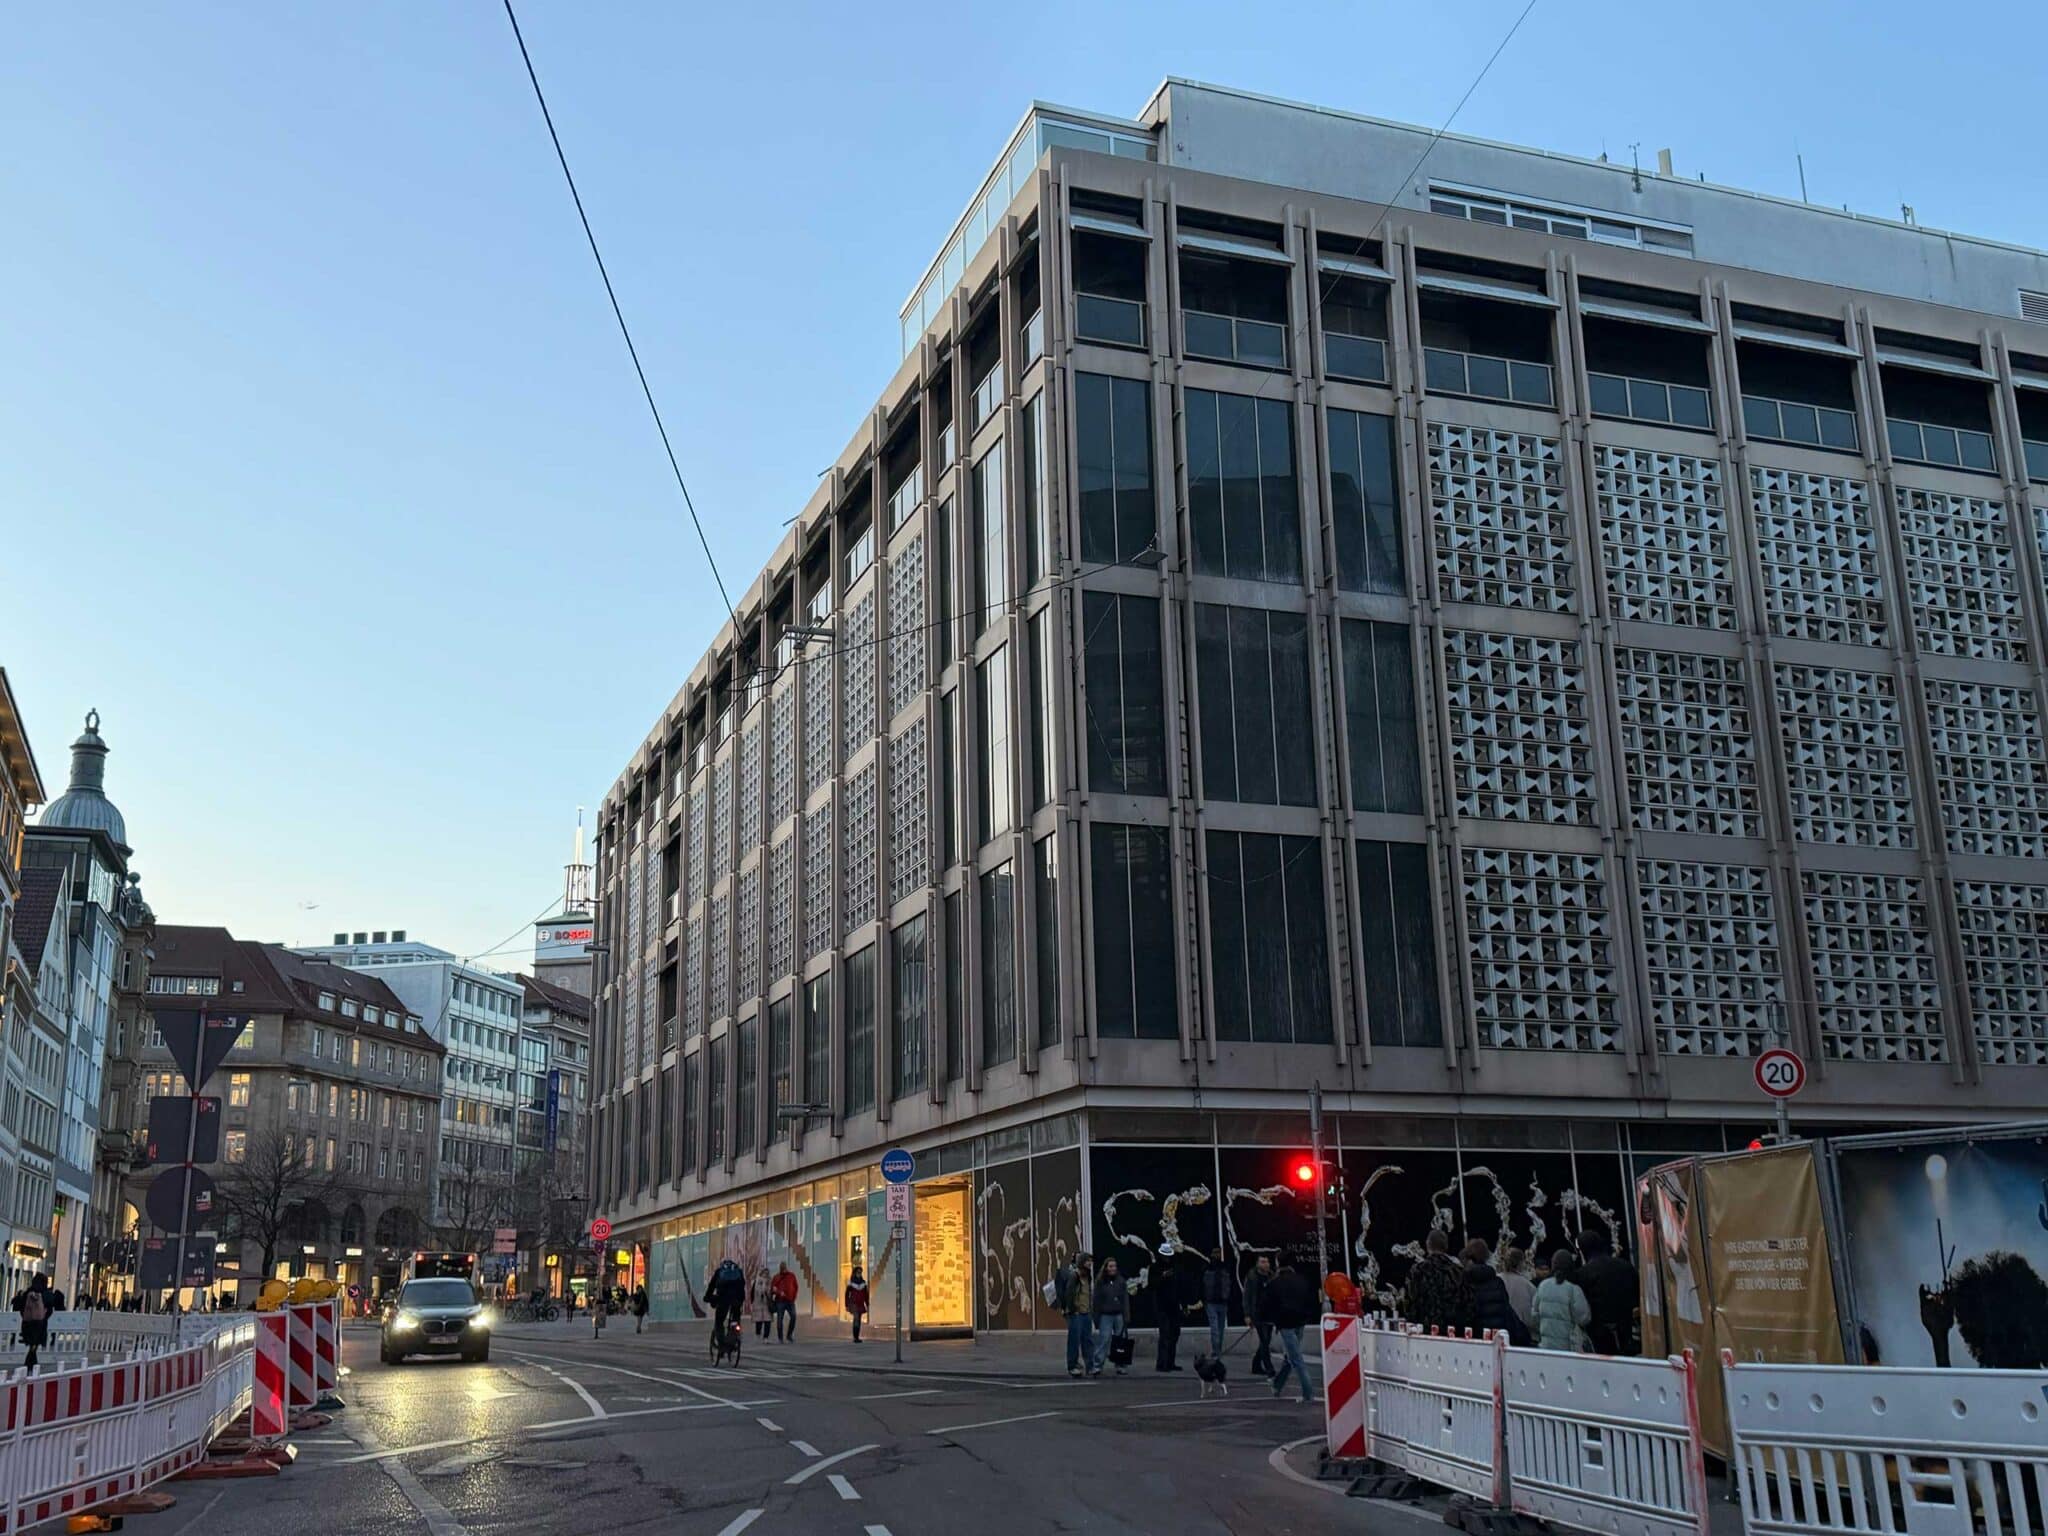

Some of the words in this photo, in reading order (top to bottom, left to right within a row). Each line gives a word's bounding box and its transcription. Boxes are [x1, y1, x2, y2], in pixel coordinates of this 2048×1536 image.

[554, 928, 592, 941] BOSCH
[1766, 1062, 1794, 1084] 20
[595, 1224, 607, 1234] 20
